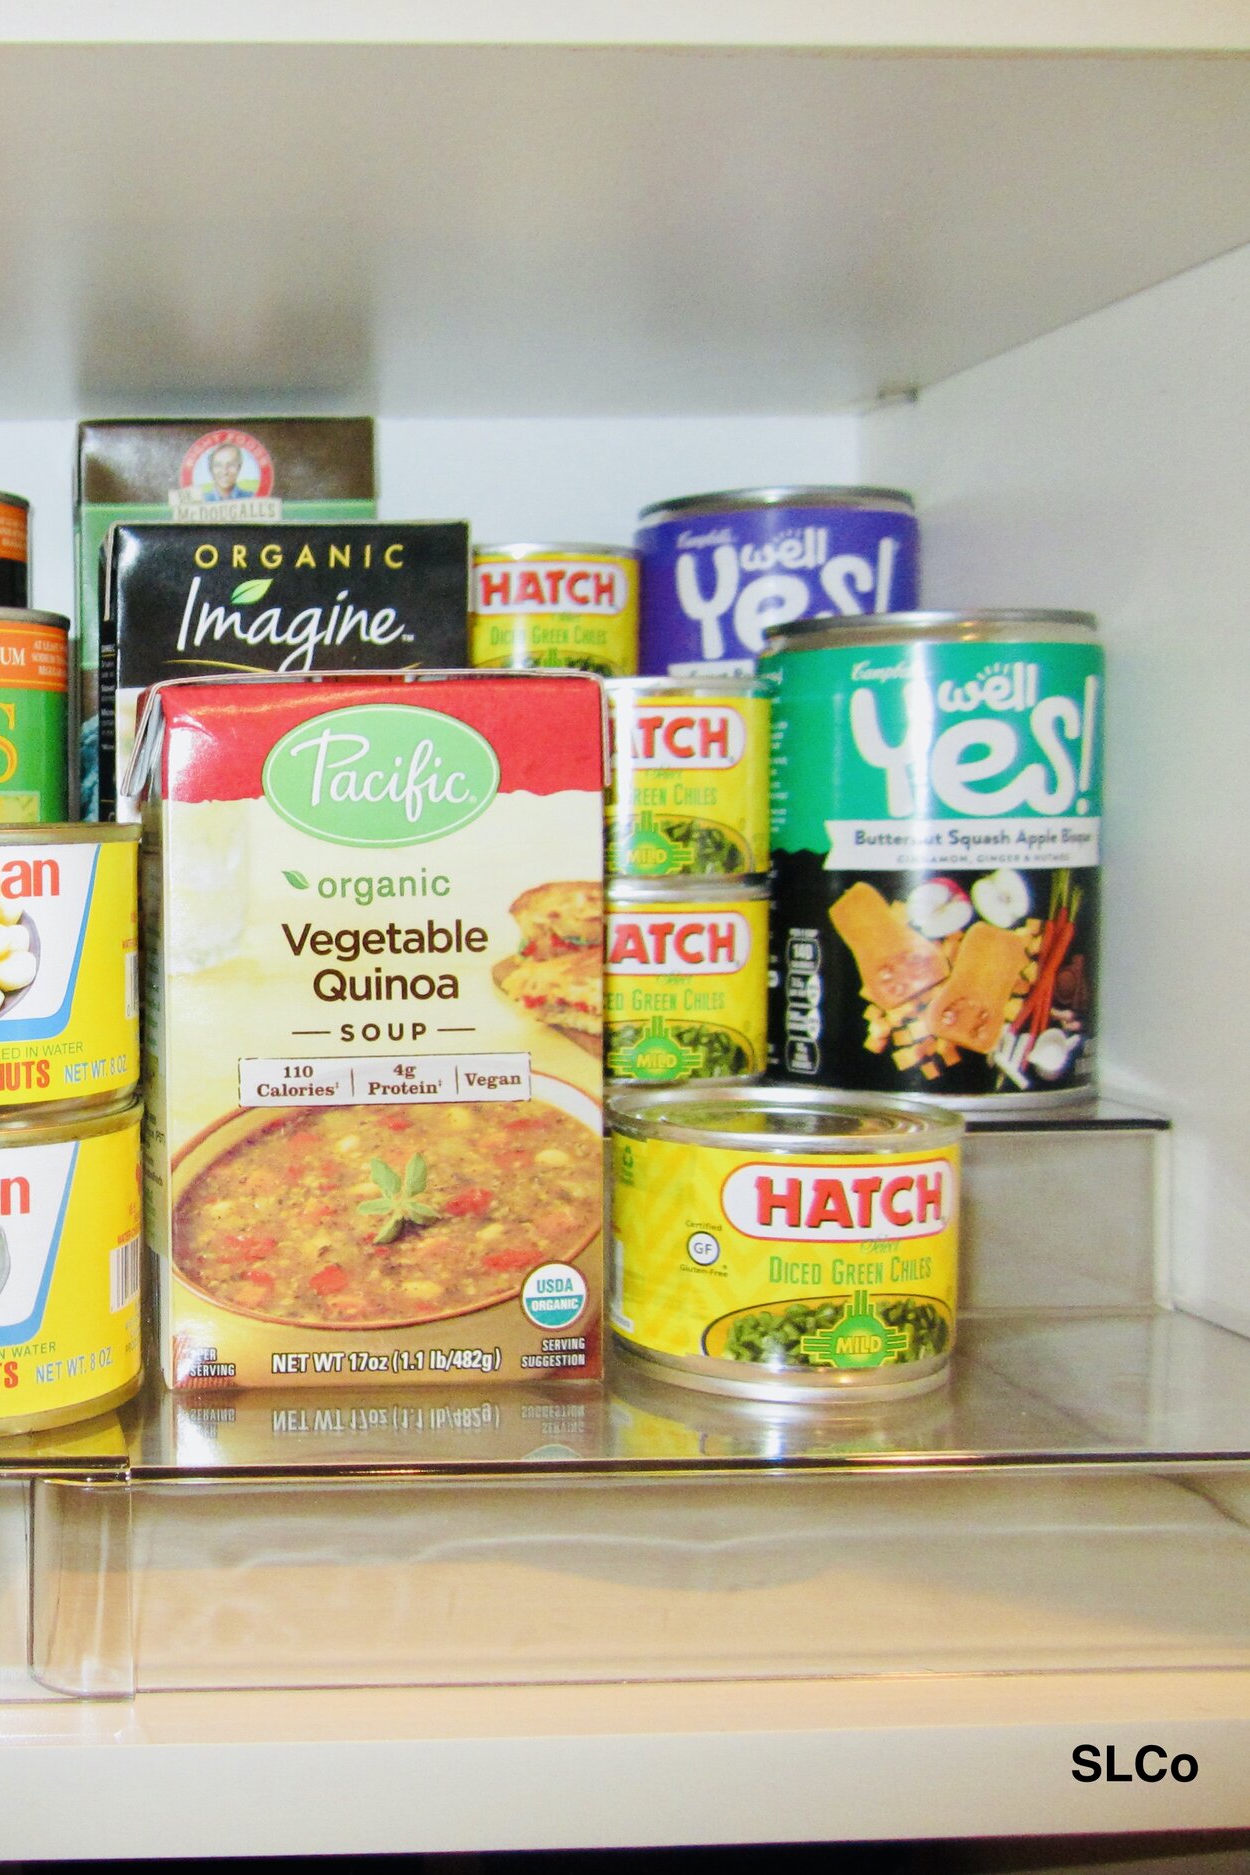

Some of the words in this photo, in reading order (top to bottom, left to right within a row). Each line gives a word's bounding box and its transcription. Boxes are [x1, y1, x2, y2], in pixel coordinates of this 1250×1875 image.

[194, 543, 405, 569] ORGANIC
[480, 570, 616, 607] HATCH
[176, 576, 406, 673] Imagine
[851, 674, 1099, 819] Yes!
[289, 727, 472, 823] Pacific
[948, 829, 1010, 851] Squash
[1015, 829, 1058, 850] Apple
[317, 867, 451, 906] organic
[281, 918, 490, 961] Vegetable
[607, 921, 736, 965] ATCH
[312, 966, 460, 1003] Quinoa
[631, 989, 677, 1012] GREEN
[684, 988, 726, 1011] CHILES
[340, 1022, 428, 1042] SOUP
[23, 1045, 39, 1060] IN
[41, 1041, 84, 1057] WATER
[636, 1053, 678, 1069] MILD
[63, 1062, 90, 1084] NET
[91, 1059, 108, 1080] WT.
[109, 1058, 117, 1075] 8
[117, 1054, 128, 1074] OZ
[283, 1064, 313, 1079] 110
[393, 1063, 417, 1080] 4g
[464, 1070, 522, 1089] Vegan
[754, 1170, 944, 1229] HATCH
[684, 1219, 723, 1232] Certified
[693, 1241, 713, 1255] GF
[678, 1263, 729, 1278] Gluten-Free
[768, 1255, 822, 1286] DICED
[831, 1255, 884, 1286] GREEN
[889, 1255, 932, 1283] CHILES
[536, 1278, 574, 1295] USDA
[531, 1298, 579, 1312] ORGANIC
[11, 1341, 57, 1358] WATER
[541, 1337, 586, 1352] SERVING
[835, 1335, 883, 1356] MILD
[35, 1361, 63, 1384] NET
[65, 1355, 87, 1377] WT.
[89, 1352, 97, 1371] 8
[97, 1346, 113, 1368] OZ
[189, 1363, 236, 1377] SERVING
[271, 1353, 309, 1374] NET
[310, 1352, 345, 1373] WT
[348, 1352, 389, 1373] 17oz
[392, 1351, 425, 1374] (1.1
[431, 1348, 502, 1373] lb/482g)
[520, 1353, 586, 1369] SUGGESTION
